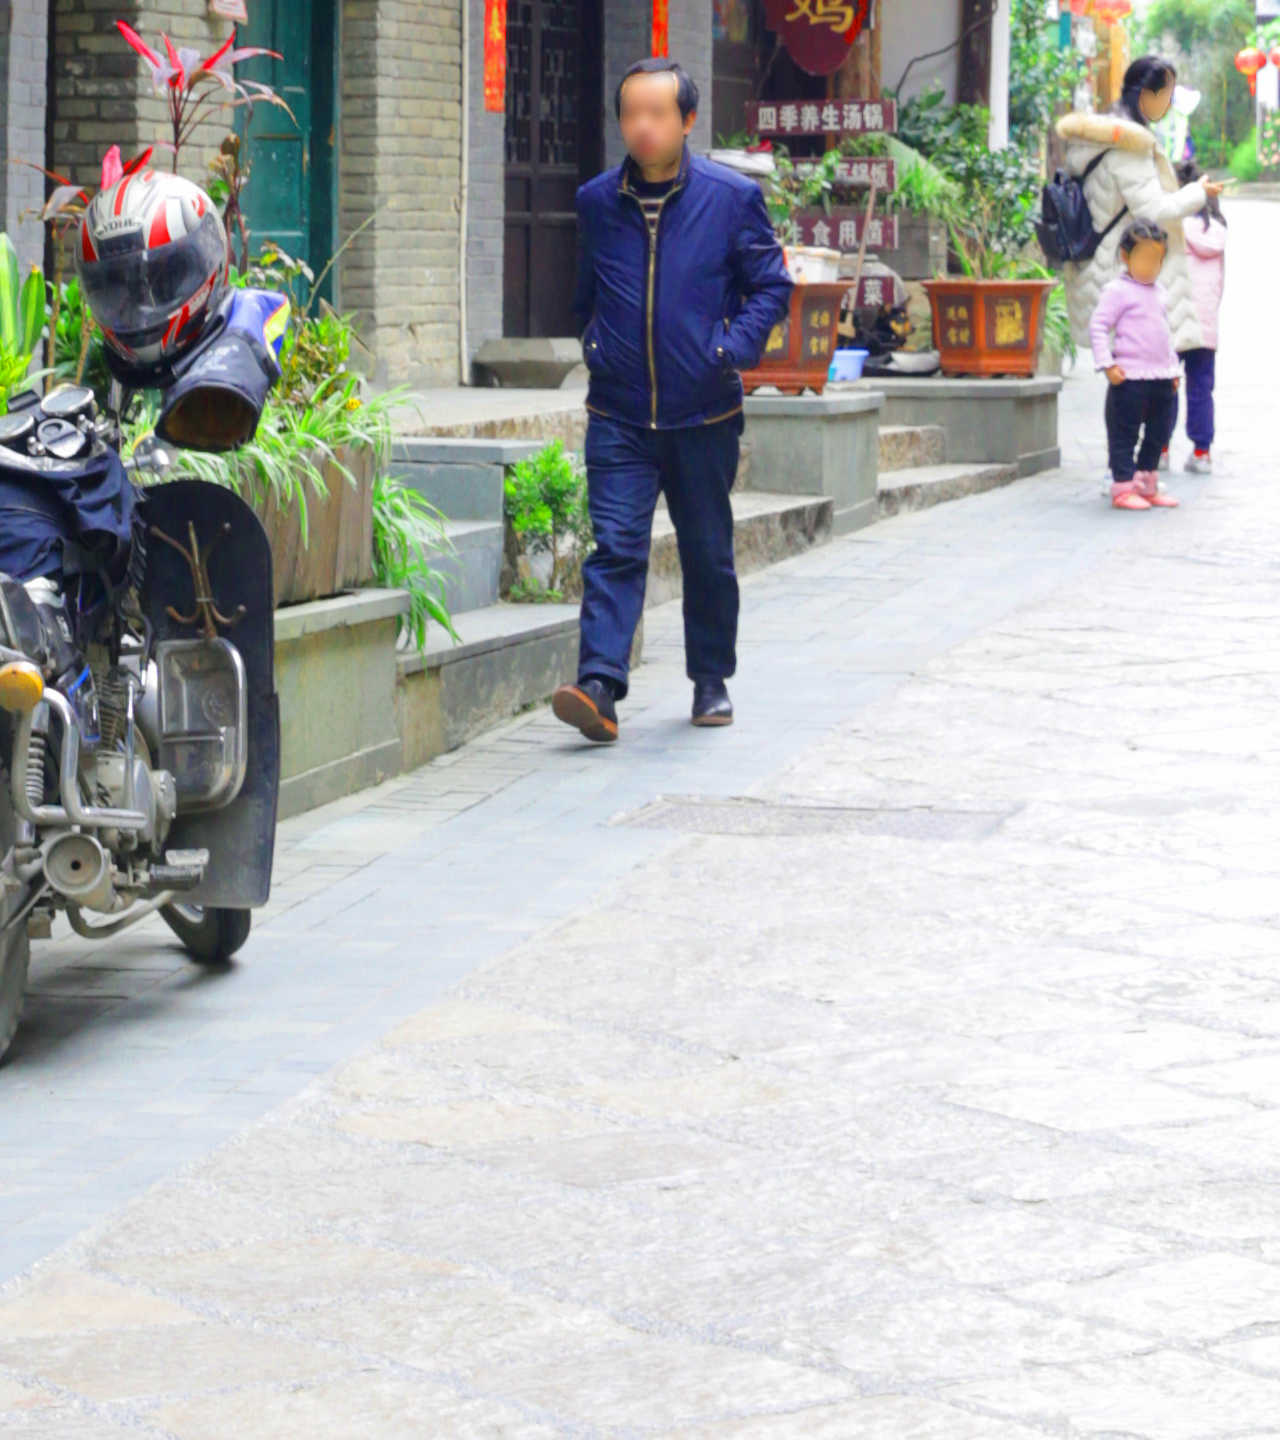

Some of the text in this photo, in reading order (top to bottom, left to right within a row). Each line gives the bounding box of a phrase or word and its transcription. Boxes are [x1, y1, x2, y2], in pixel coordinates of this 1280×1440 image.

[757, 103, 884, 132] 四季养生汤锅
